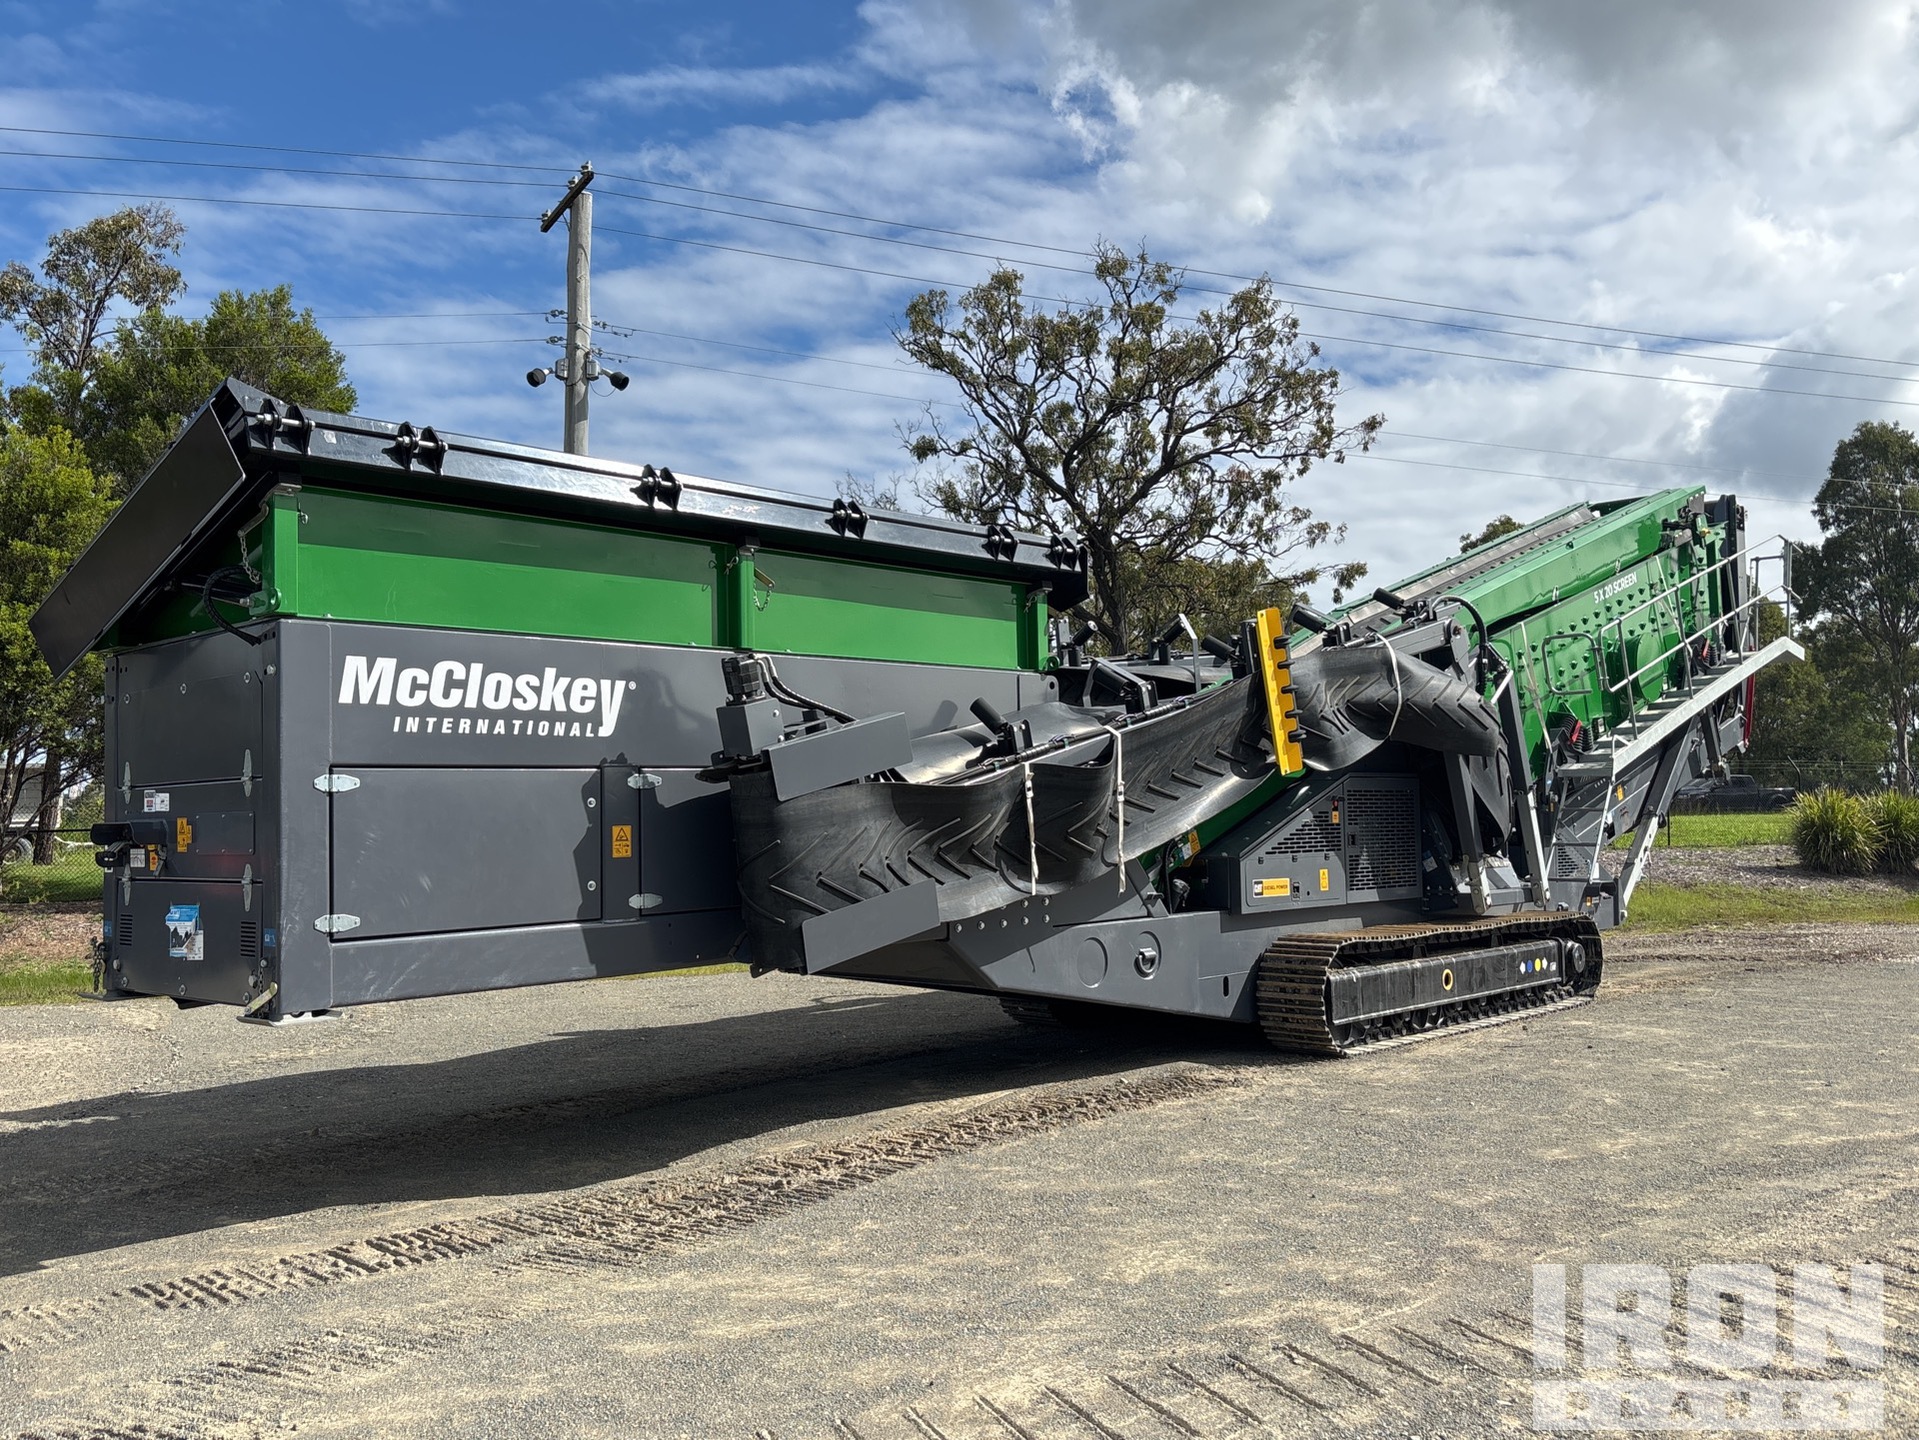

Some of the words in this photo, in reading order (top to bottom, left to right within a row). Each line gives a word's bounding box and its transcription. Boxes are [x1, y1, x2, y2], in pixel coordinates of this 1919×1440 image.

[1593, 591, 1599, 604] 5
[1604, 584, 1613, 599] 20
[1613, 571, 1638, 594] SCREEN
[393, 716, 596, 738] INTERNATIONAL
